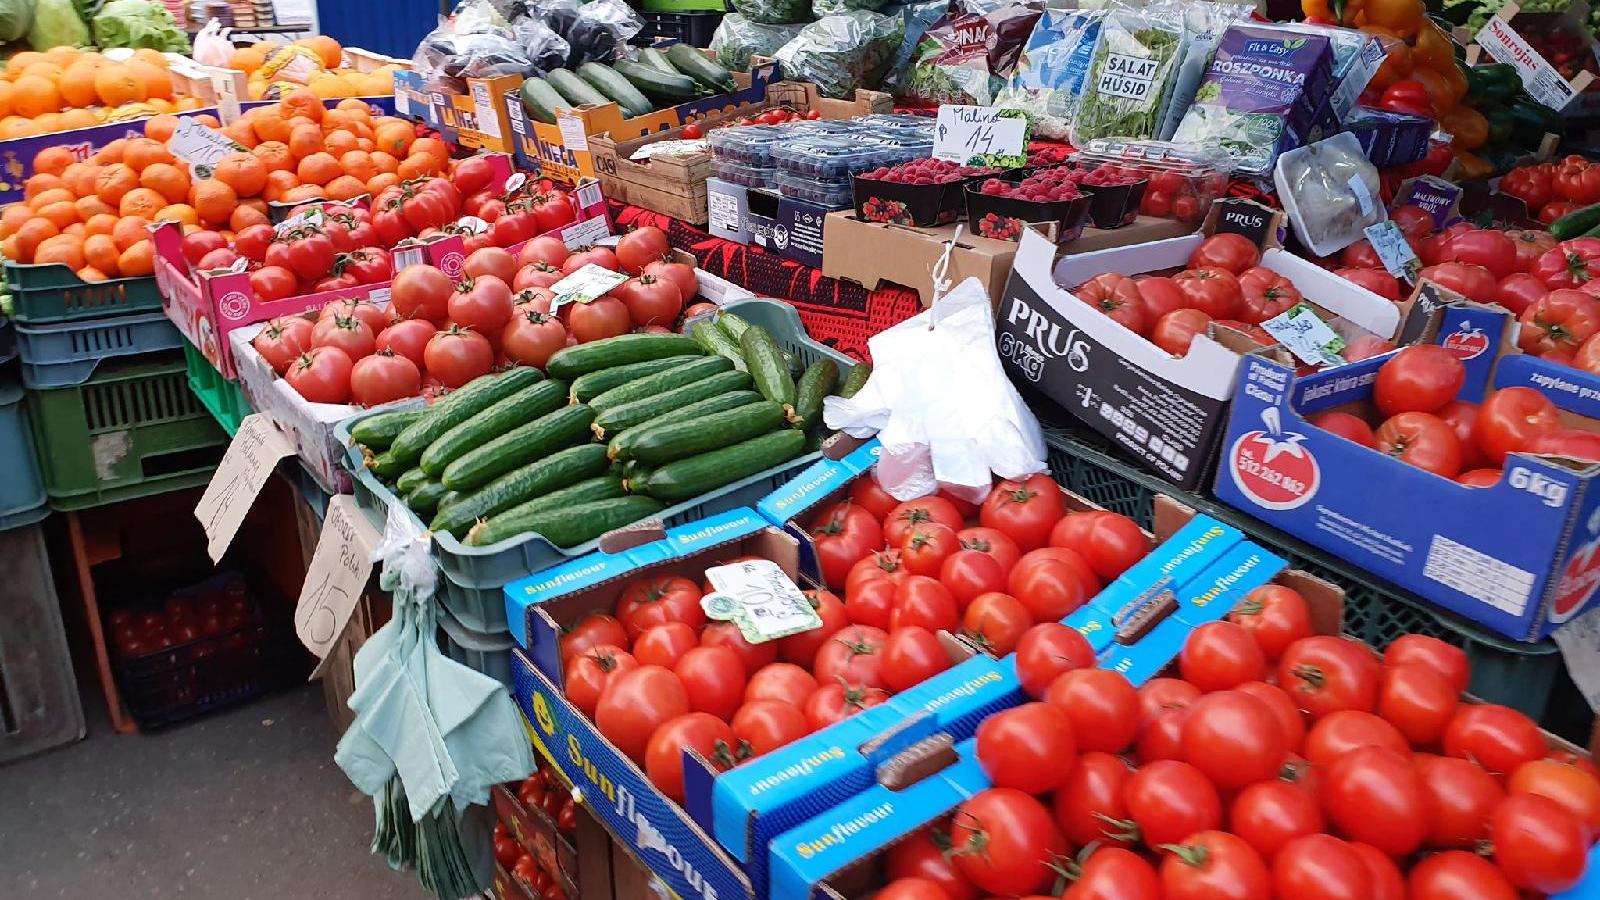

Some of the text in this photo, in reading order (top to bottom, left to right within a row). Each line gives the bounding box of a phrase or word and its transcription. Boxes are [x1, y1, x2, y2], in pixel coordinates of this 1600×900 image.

[1248, 42, 1289, 57] Fit & Easy
[1489, 20, 1539, 71] Sonrojas
[1108, 57, 1156, 77] SALAT
[1212, 60, 1306, 86] ROSZPONKA
[965, 124, 995, 155] 14
[1225, 211, 1264, 228] PRUS
[1007, 297, 1092, 373] PRUS
[776, 467, 838, 510] Sunflavour
[1508, 466, 1569, 508] 6kg
[678, 515, 751, 545] Sunflavour
[1160, 526, 1226, 574] Sunflavour
[524, 560, 606, 596] Sunflavour
[1191, 554, 1261, 607] Sunflavour
[301, 571, 349, 645] 15
[924, 670, 1003, 712] Sunflavour
[748, 745, 846, 796] Sunflavour
[567, 733, 718, 900] Sunflour
[796, 801, 894, 859] Sunflavour
